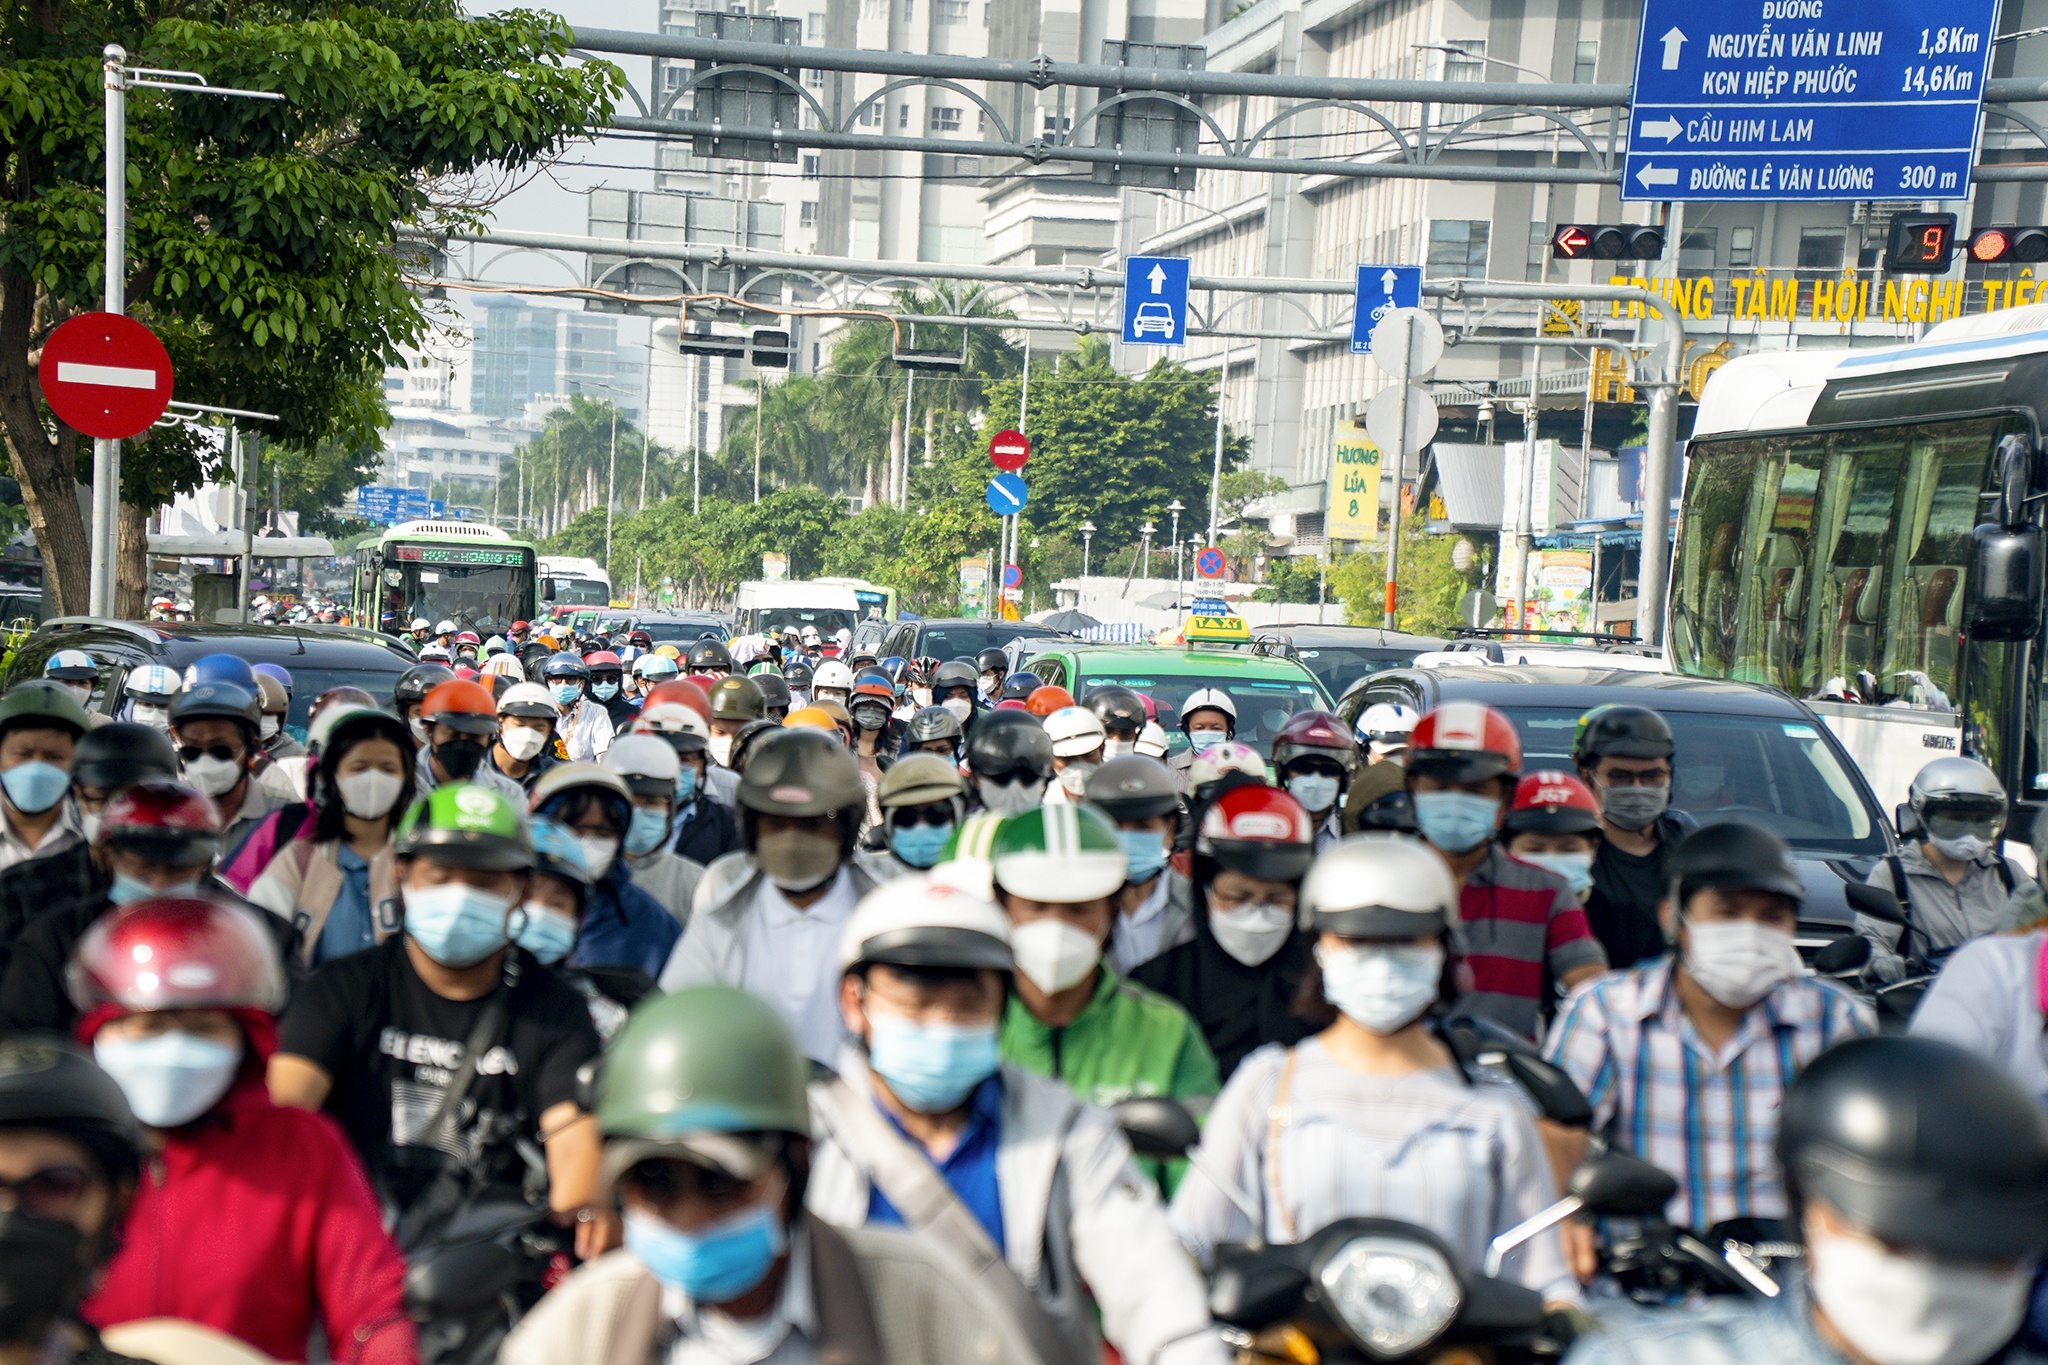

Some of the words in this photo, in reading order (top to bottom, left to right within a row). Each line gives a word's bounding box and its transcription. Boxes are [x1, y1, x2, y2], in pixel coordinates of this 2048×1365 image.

[1707, 24, 1784, 58] NGUYỄN
[1791, 28, 1831, 57] VĂN
[1836, 32, 1883, 56] LINH
[1918, 27, 1979, 59] 1,8Km
[1702, 71, 1740, 95] KCN
[1744, 68, 1787, 99] HIỆP
[1793, 63, 1858, 93] PHƯỚC
[1902, 66, 1974, 97] 14,6Km
[1687, 111, 1723, 143] CẦU
[1728, 120, 1764, 142] HIM
[1771, 119, 1814, 142] LAM
[1690, 162, 1746, 190] ĐƯỜNG
[1750, 163, 1773, 190] LÊ
[1779, 164, 1812, 190] VĂN
[1818, 166, 1873, 190] LƯƠNG
[1900, 165, 1936, 189] 300
[1940, 173, 1957, 189] m
[1922, 227, 1942, 260] 9
[1609, 276, 1714, 320] TRUNG
[1732, 267, 1798, 322] TÂM
